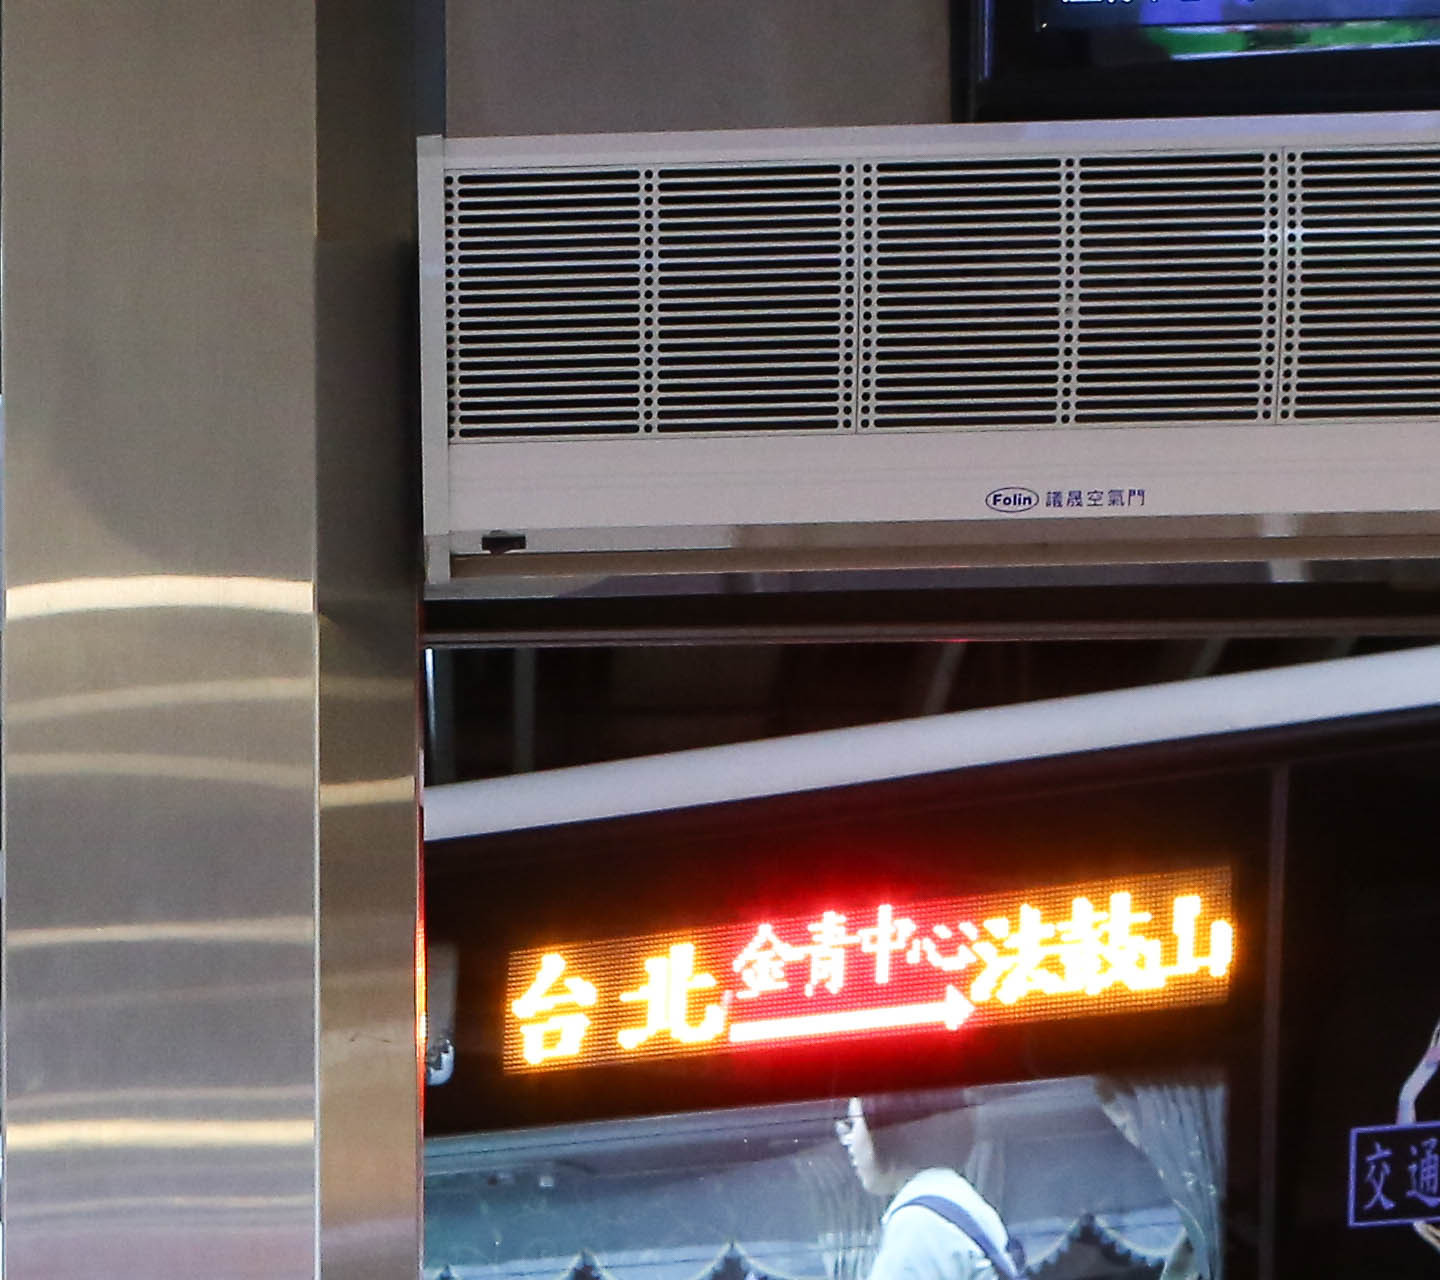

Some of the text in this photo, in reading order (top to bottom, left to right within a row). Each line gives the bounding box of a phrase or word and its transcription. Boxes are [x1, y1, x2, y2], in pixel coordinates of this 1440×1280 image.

[992, 493, 1032, 506] Folin
[511, 890, 1235, 1067] 台北 金青中心 法鼓山
